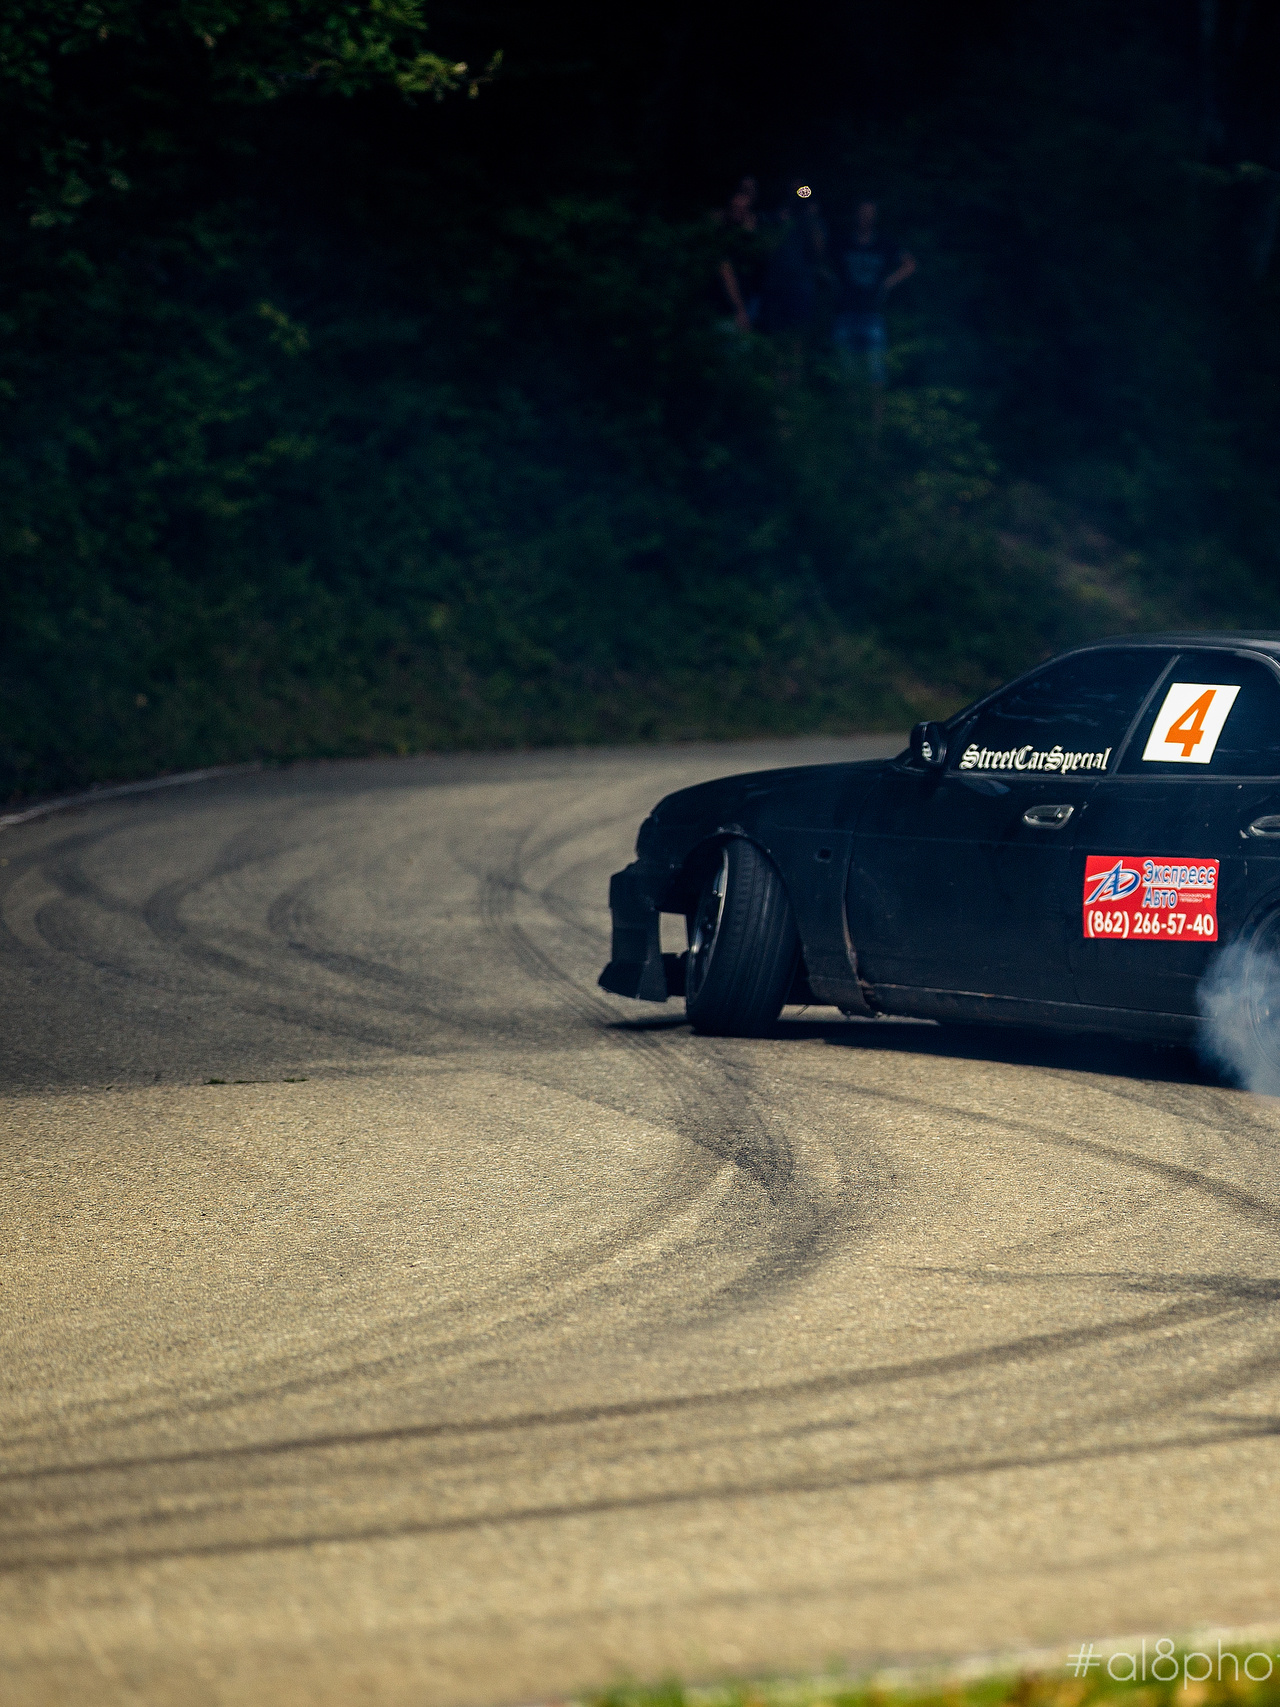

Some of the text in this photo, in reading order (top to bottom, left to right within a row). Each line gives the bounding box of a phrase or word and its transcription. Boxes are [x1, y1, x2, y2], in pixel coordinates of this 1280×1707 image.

[1164, 689, 1217, 757] 4
[959, 743, 1113, 775] StreetCarSpecial
[1142, 860, 1217, 889] Экспресс
[1142, 886, 1179, 908] Авто
[1087, 910, 1215, 939] (862) 266-57-40
